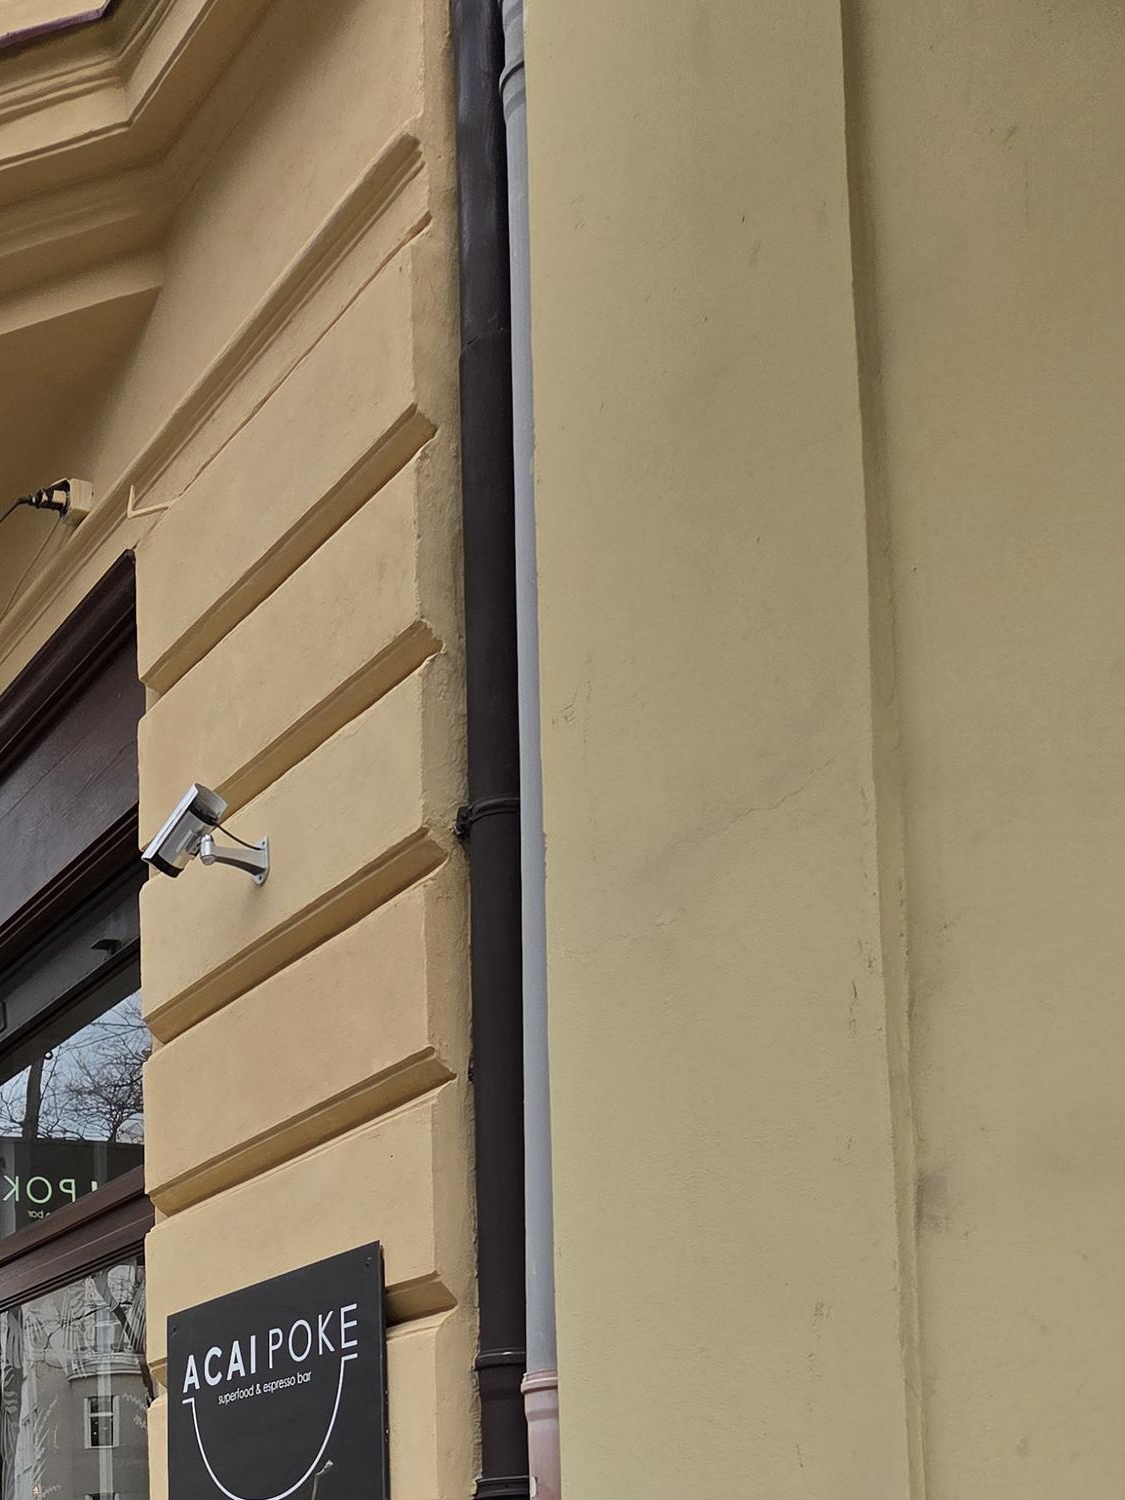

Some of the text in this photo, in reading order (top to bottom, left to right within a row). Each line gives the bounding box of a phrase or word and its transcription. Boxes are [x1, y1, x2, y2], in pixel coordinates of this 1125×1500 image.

[182, 1303, 358, 1393] ACAI POKE
[218, 1371, 312, 1405] superfood & espresso bar
